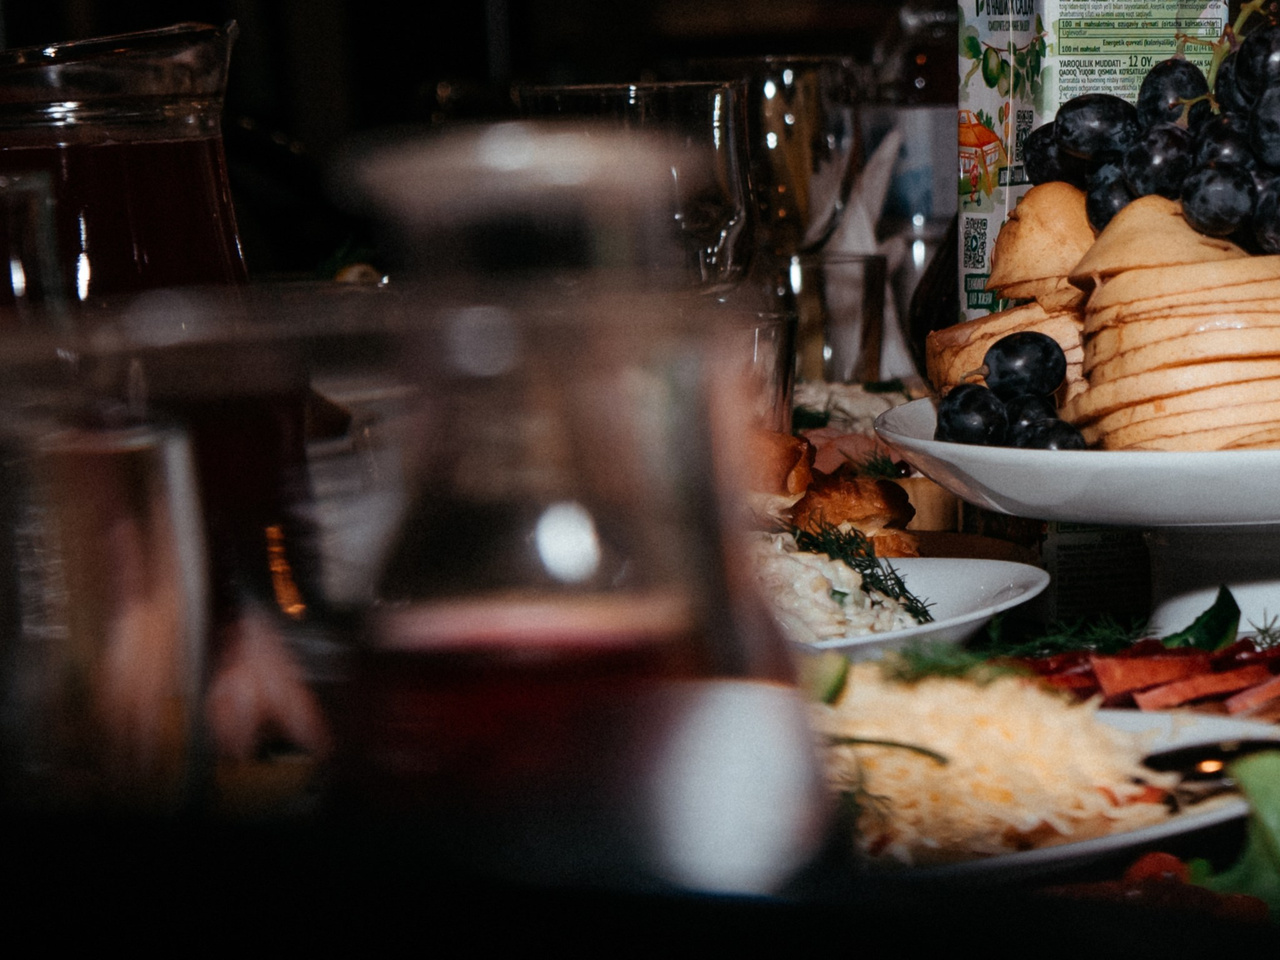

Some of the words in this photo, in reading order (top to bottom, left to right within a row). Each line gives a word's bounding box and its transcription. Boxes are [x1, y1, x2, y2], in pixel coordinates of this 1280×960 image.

[1059, 60, 1093, 69] YAROQLILIK
[1095, 60, 1121, 68] MUDDATI
[1129, 56, 1138, 67] 12
[1141, 56, 1153, 67] OY.
